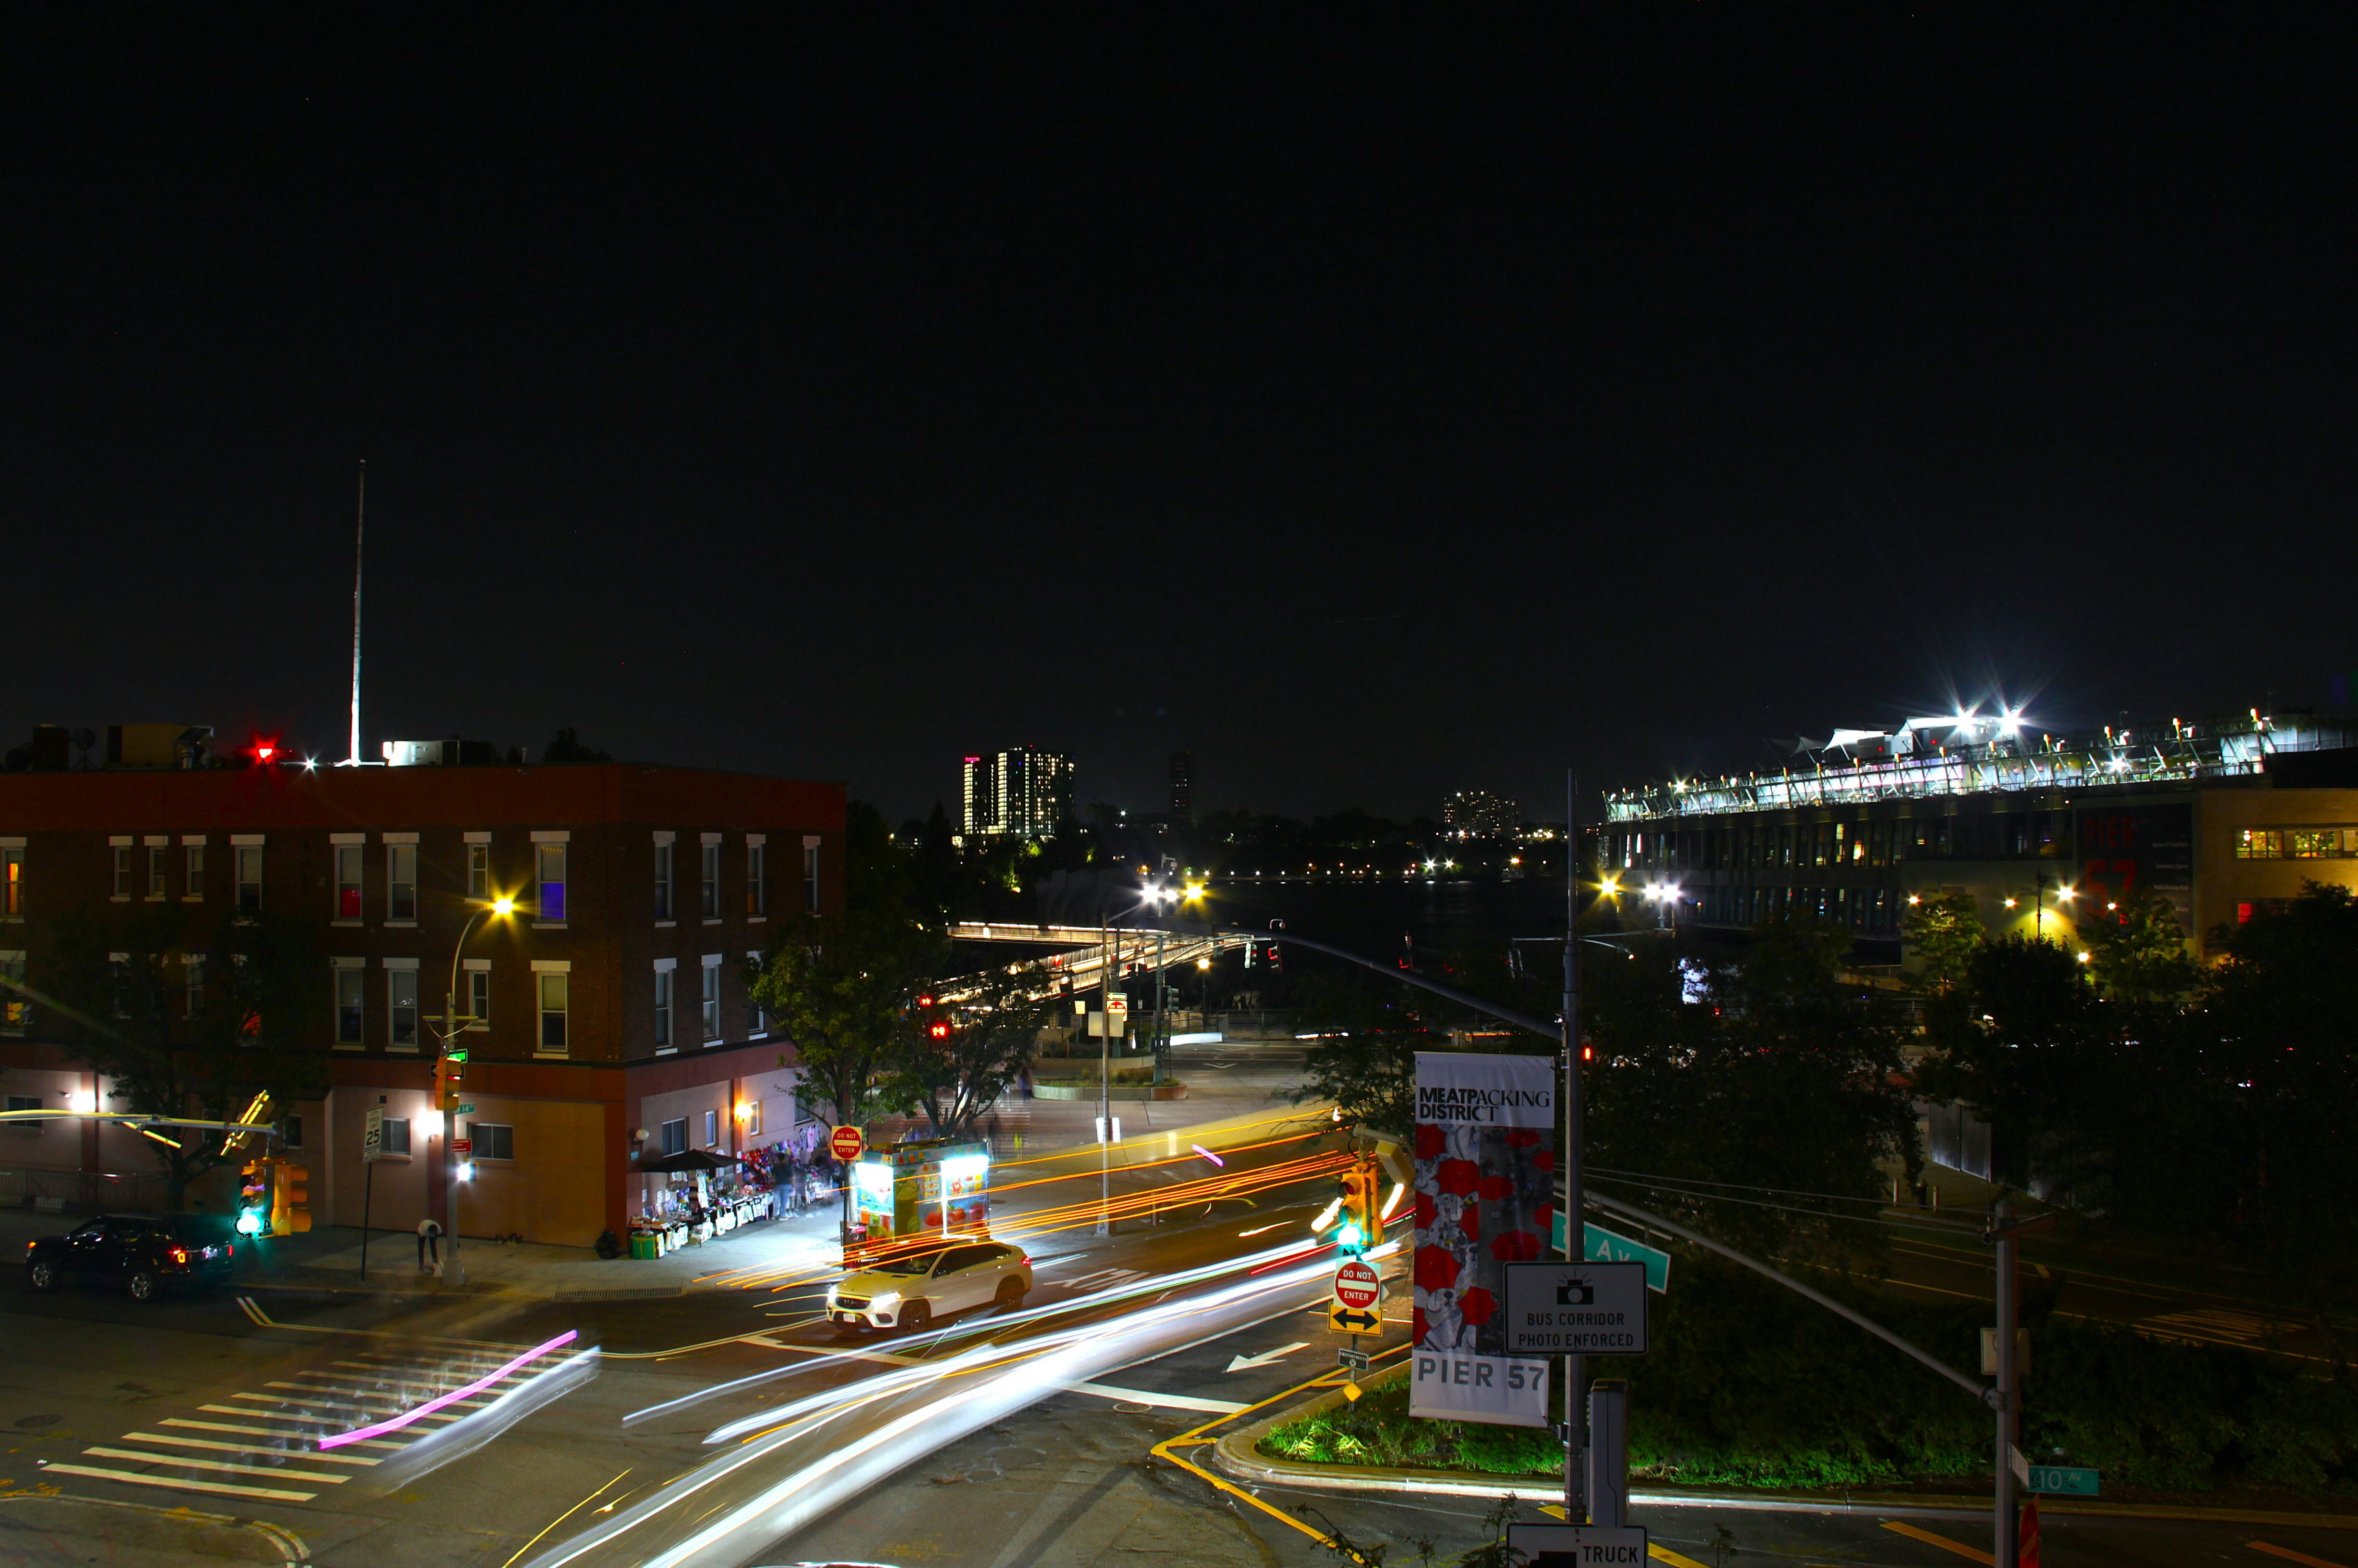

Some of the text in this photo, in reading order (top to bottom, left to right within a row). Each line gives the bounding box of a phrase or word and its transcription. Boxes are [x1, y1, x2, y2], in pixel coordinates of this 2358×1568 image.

[2084, 817, 2136, 848] PIER
[1420, 1087, 1550, 1107] MEATPACKING
[1420, 1104, 1499, 1121] DISTRICT
[366, 1129, 380, 1146] 25
[1343, 1269, 1372, 1280] DO NOT
[1344, 1291, 1369, 1301] ENTER
[1527, 1313, 1624, 1325] BUS CORRIDOR
[1519, 1334, 1633, 1346] PHOTO ENFORCED
[1418, 1357, 1544, 1391] PIER 57
[2039, 1470, 2082, 1490] 10 AV
[1583, 1546, 1638, 1563] TRUCK
